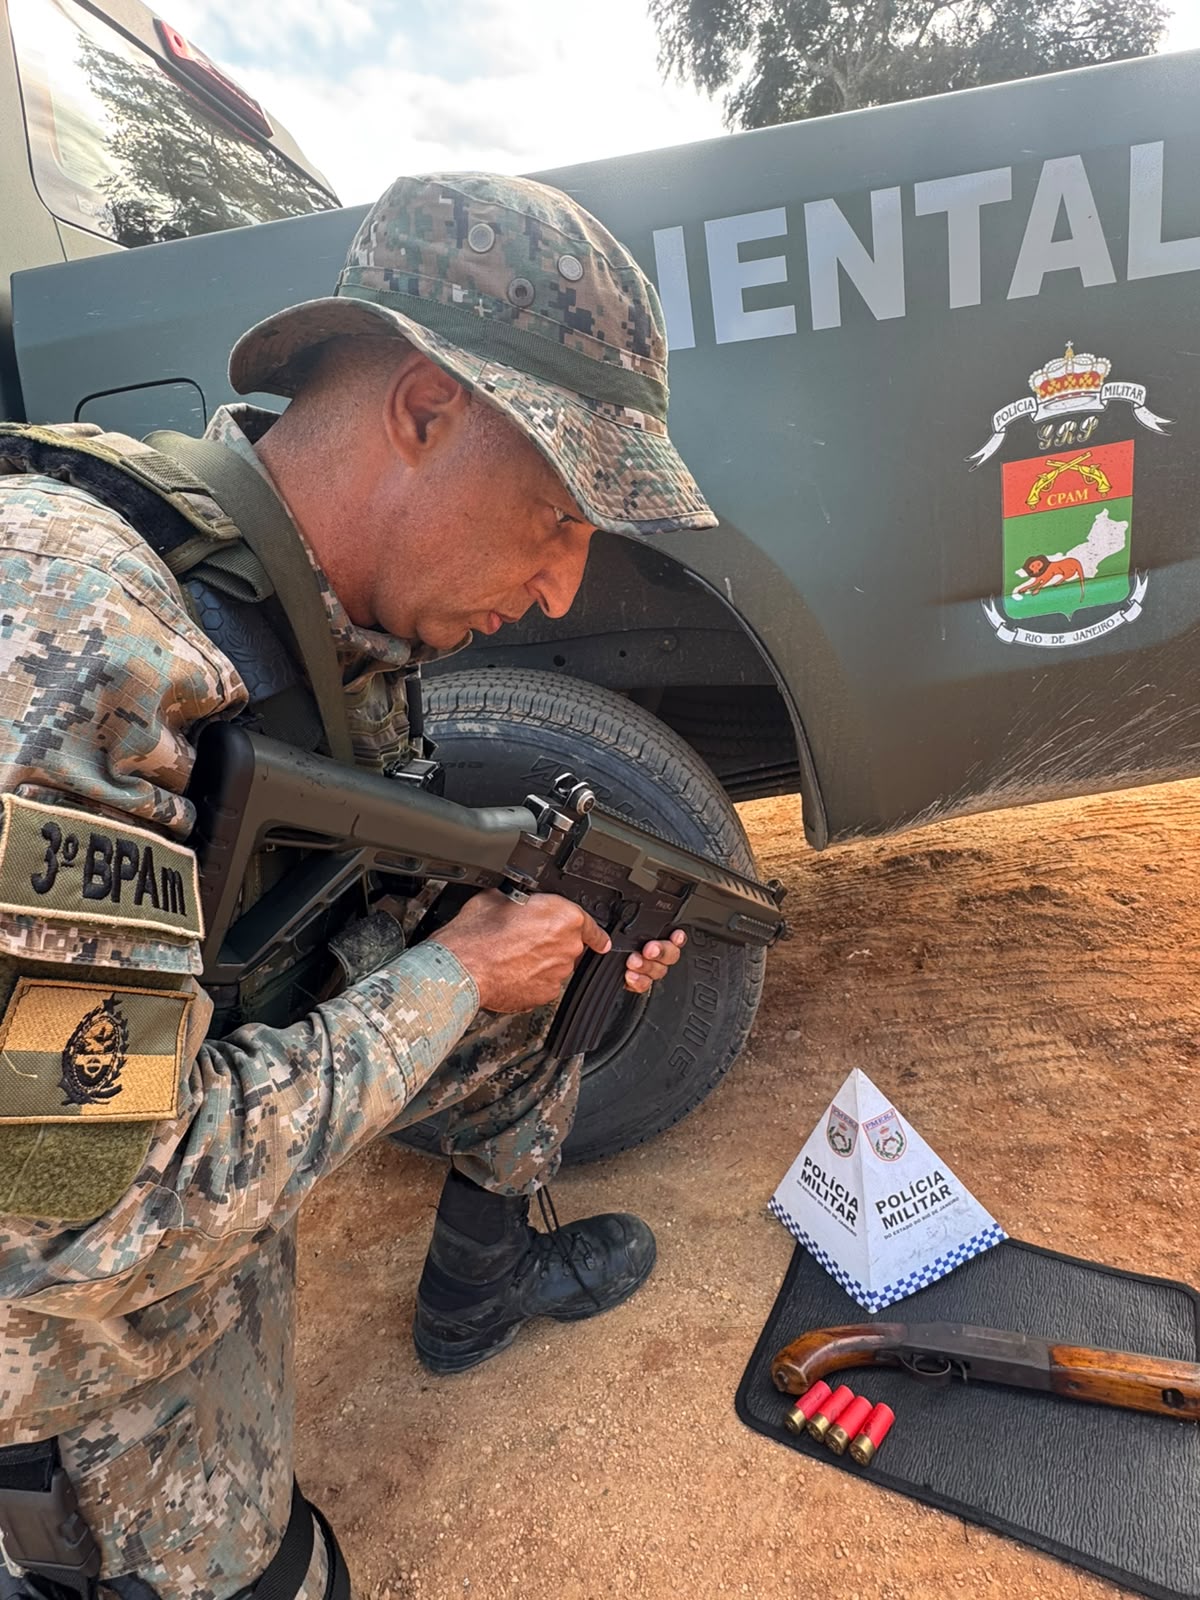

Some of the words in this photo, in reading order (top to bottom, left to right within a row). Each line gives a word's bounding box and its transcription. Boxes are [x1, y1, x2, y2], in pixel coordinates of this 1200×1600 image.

[1104, 385, 1144, 401] MILITAR
[1046, 488, 1089, 506] CPAM
[1024, 634, 1043, 644] RIO
[1051, 635, 1066, 644] DE
[1073, 618, 1115, 641] JANEIRO
[82, 832, 187, 917] BPAm
[801, 1169, 855, 1227] MILITAR
[804, 1156, 858, 1213] POLÍCIA
[875, 1170, 945, 1215] POLÍCIA
[881, 1184, 952, 1230] MILITAR
